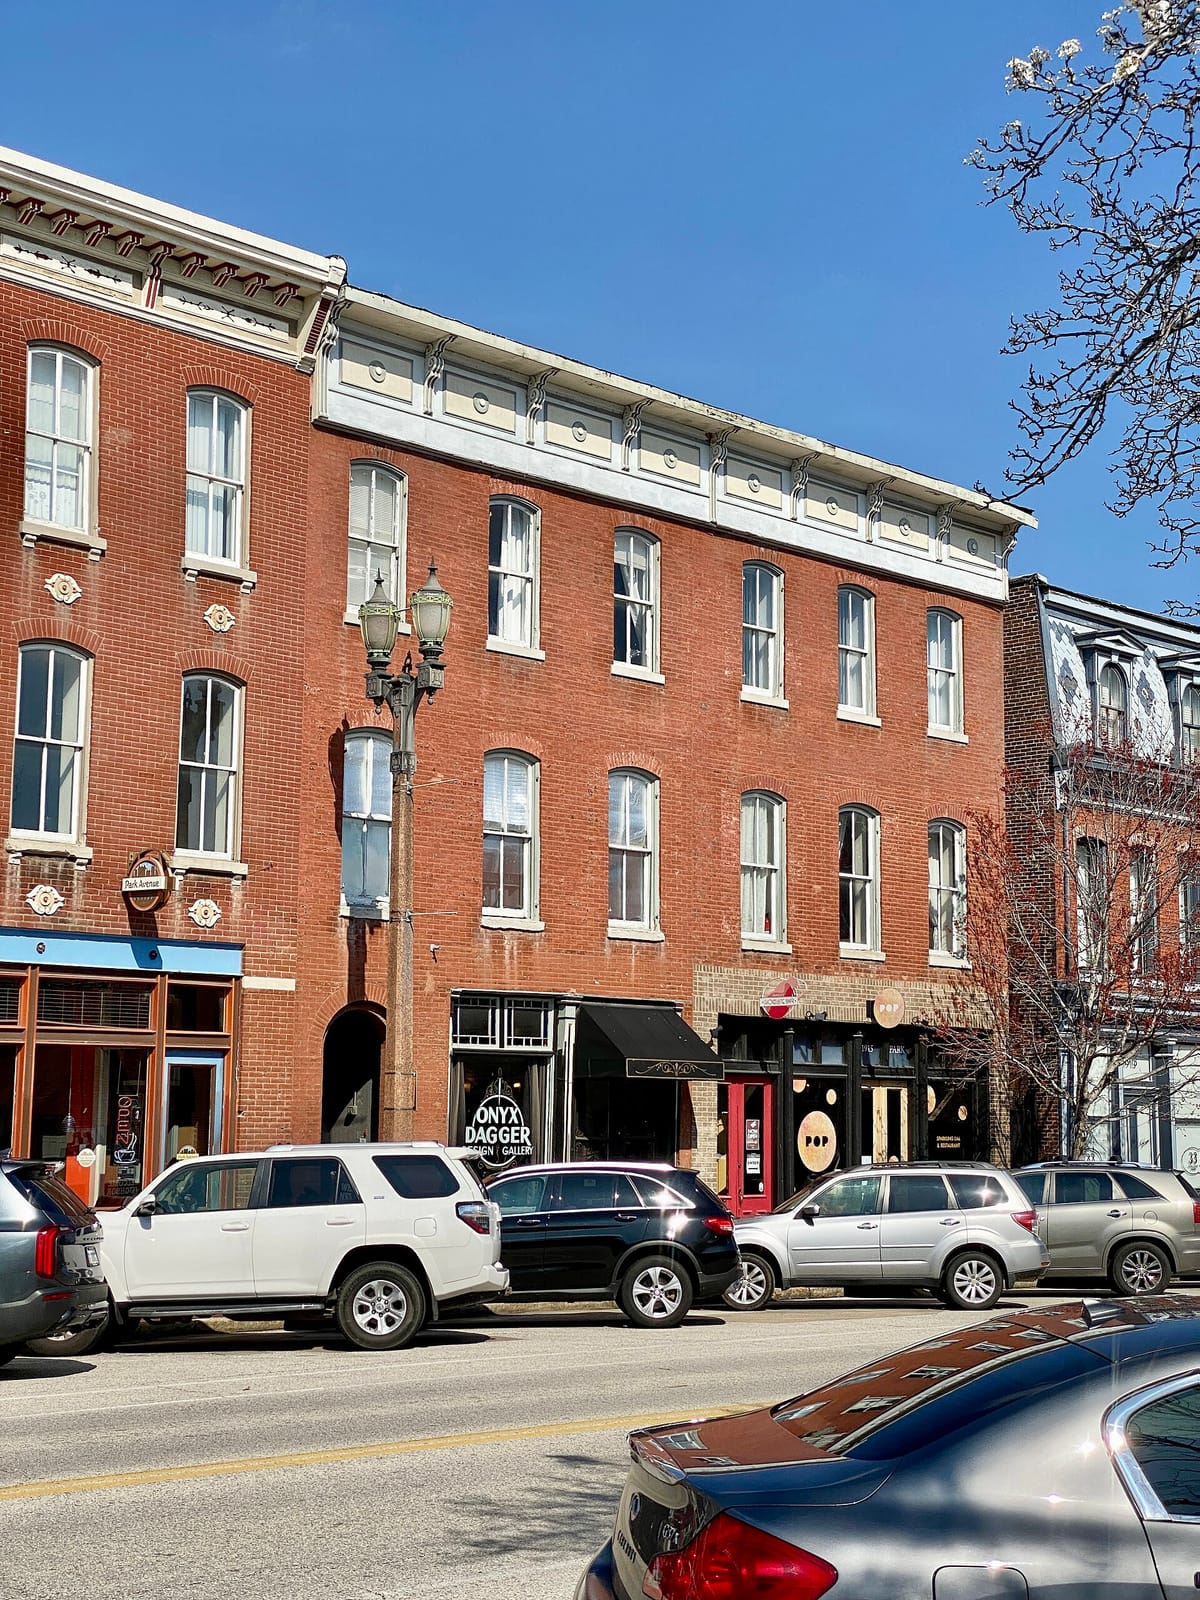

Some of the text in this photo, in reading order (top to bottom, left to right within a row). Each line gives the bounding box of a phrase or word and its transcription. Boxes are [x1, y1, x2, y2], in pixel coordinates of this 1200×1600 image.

[124, 880, 160, 889] Park Avenue
[879, 1003, 899, 1012] POP
[889, 1045, 906, 1054] PARK
[476, 1106, 519, 1124] ONYX
[465, 1126, 532, 1146] DAGGER
[805, 1135, 829, 1148] POP
[501, 1145, 534, 1155] GALLERY
